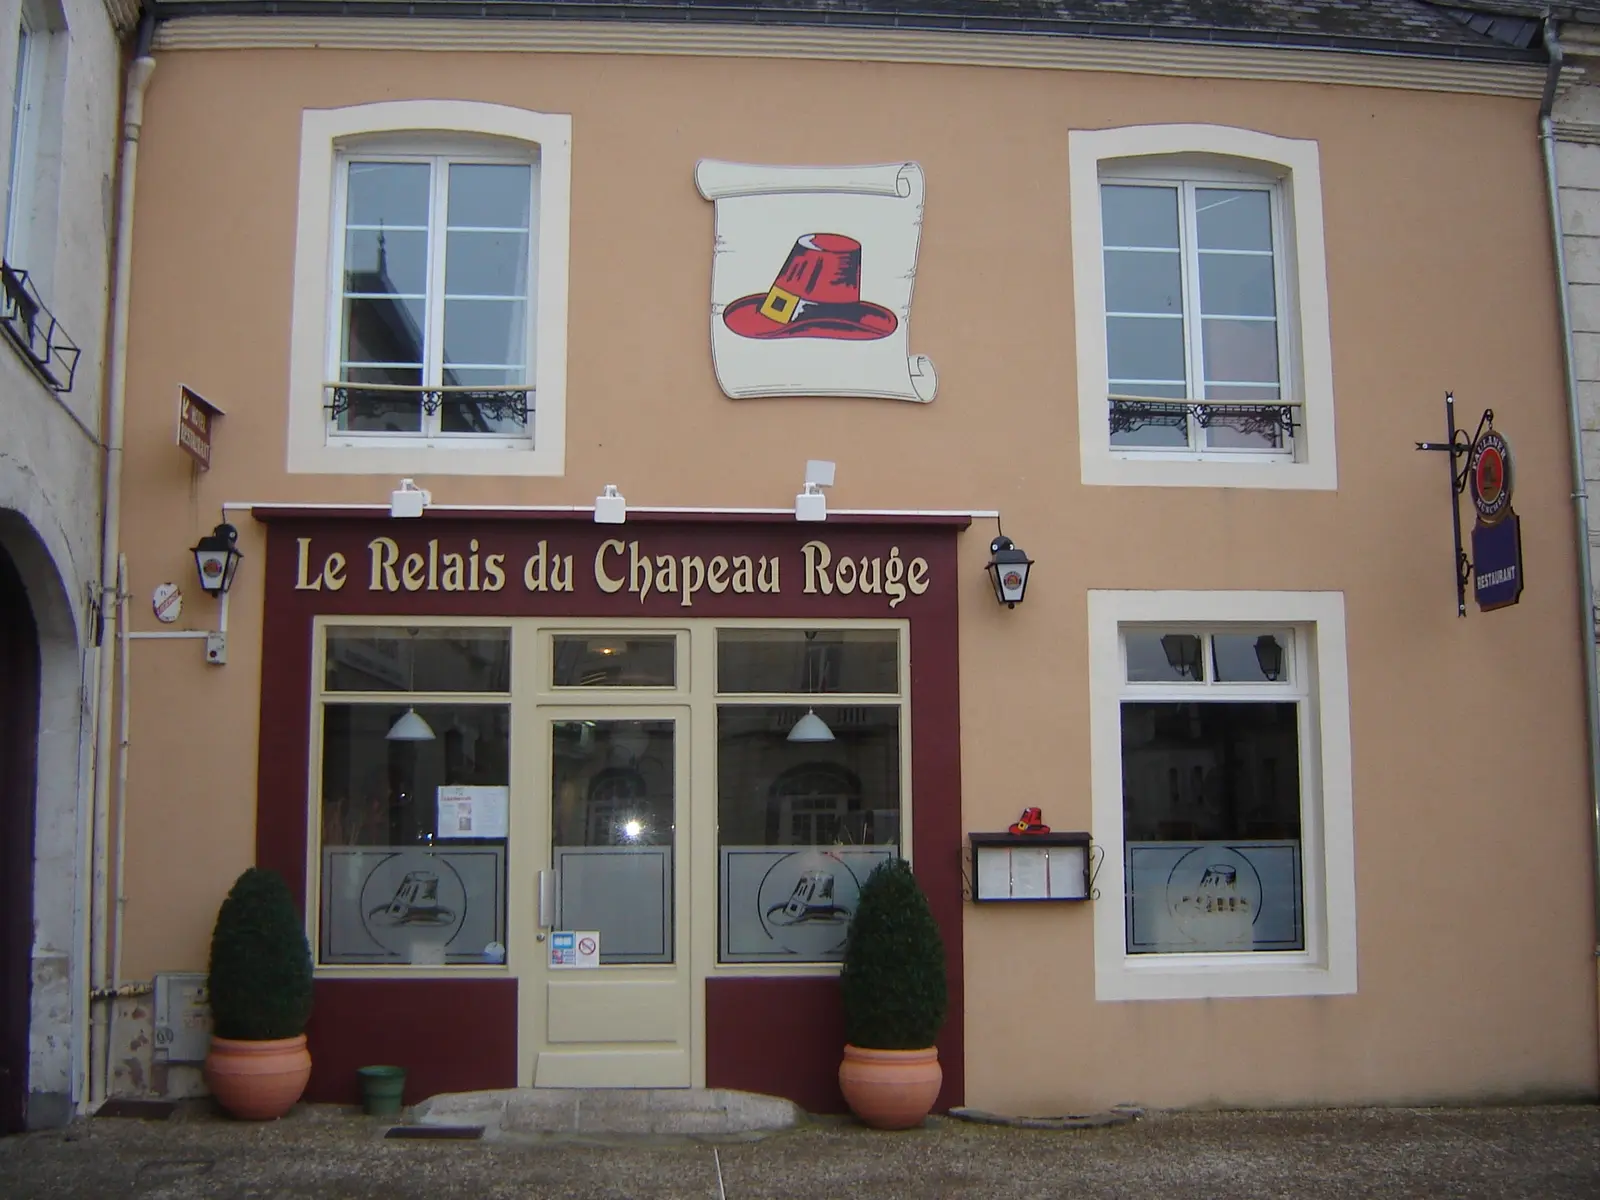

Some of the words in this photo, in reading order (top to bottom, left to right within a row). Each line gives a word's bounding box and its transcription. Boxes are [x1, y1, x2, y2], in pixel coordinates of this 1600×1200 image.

[1473, 436, 1506, 469] PAULANER
[295, 537, 346, 591] Le
[367, 538, 505, 592] Relais
[524, 540, 574, 593] du
[594, 540, 781, 606] Chapeau
[801, 541, 930, 608] Rouge
[1477, 565, 1516, 590] RESTAURANT
